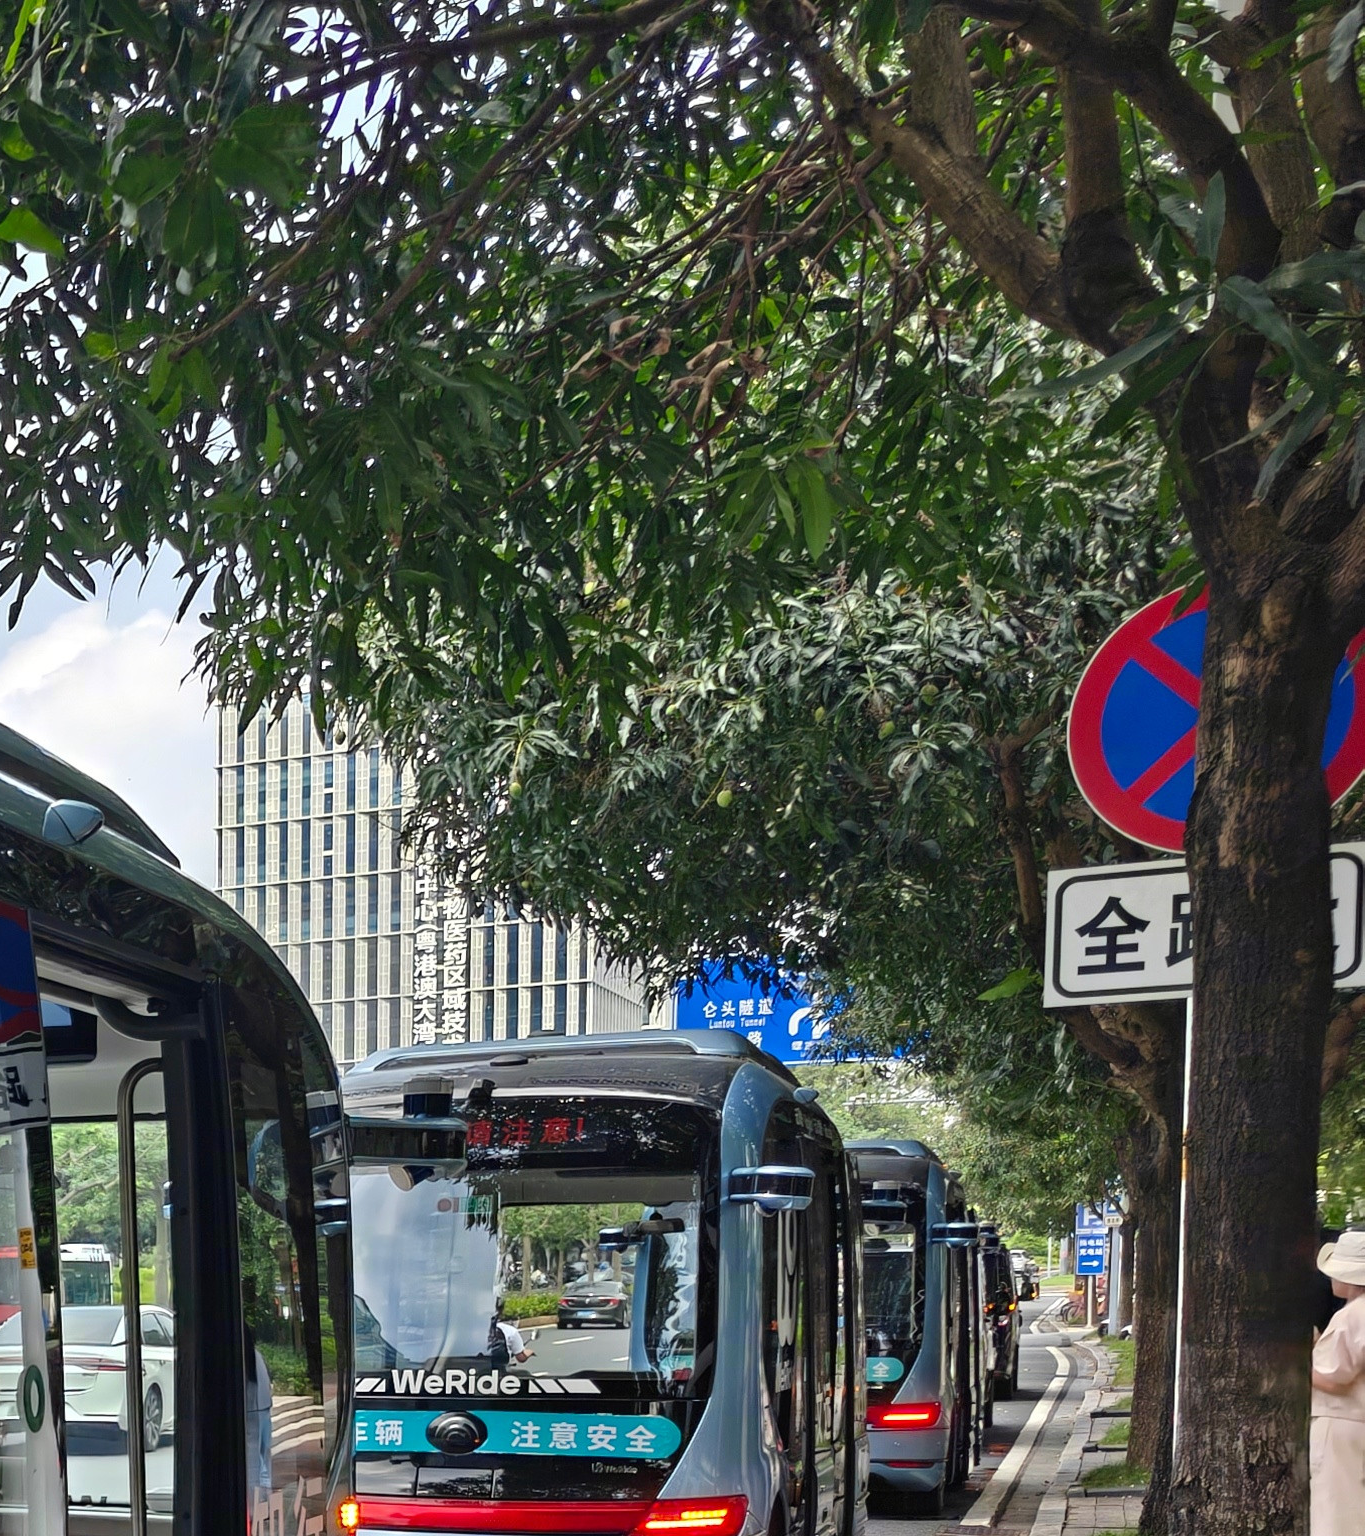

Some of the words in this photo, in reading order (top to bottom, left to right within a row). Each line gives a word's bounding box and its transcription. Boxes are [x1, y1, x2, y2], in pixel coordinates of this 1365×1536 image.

[441, 885, 467, 1045] 物医药区域技
[740, 1015, 766, 1027] Tunnel
[391, 1369, 521, 1395] WeRide
[872, 1361, 890, 1378] 全
[511, 1420, 658, 1454] 注意安全
